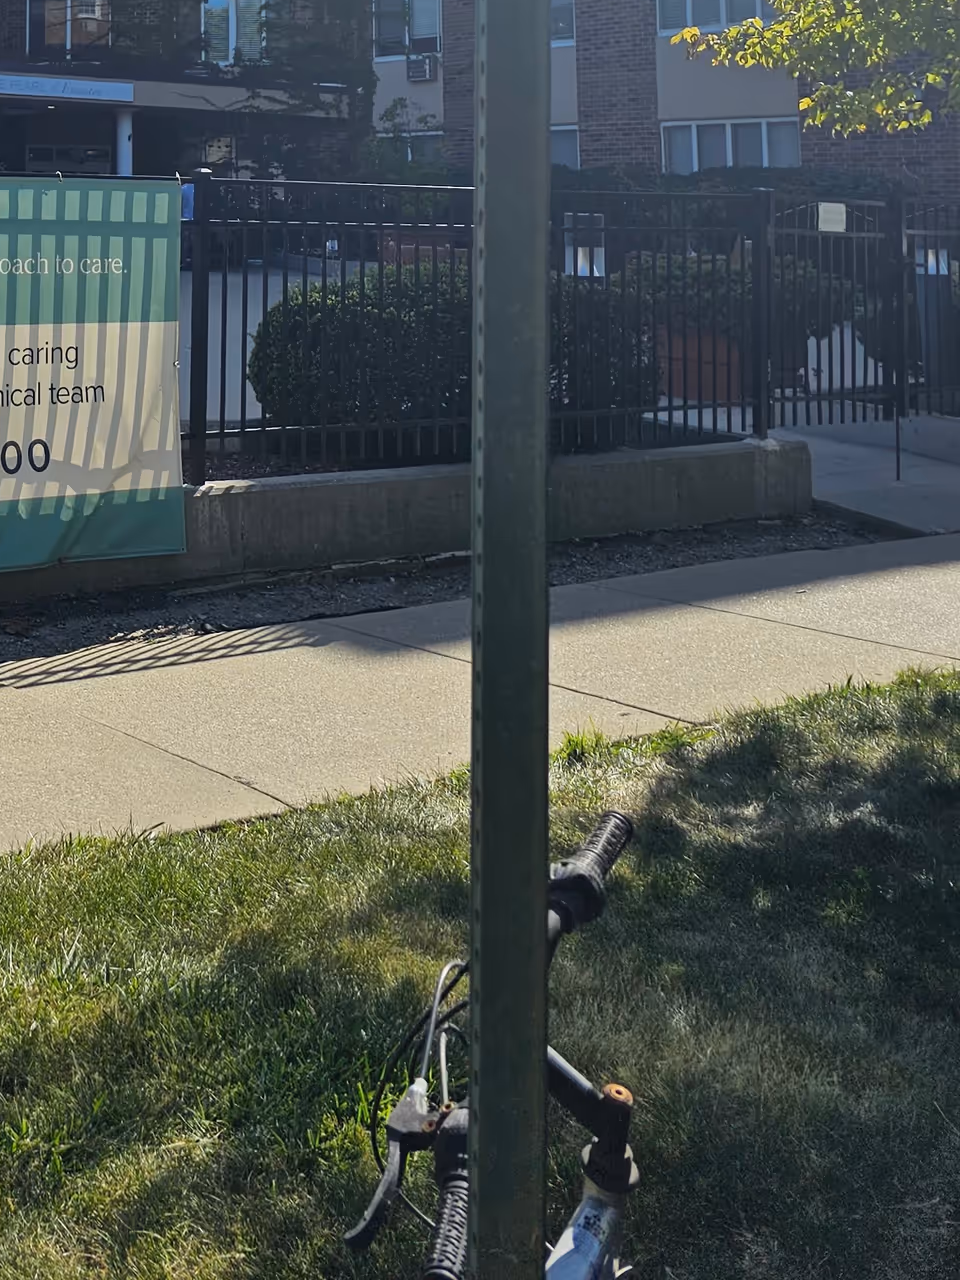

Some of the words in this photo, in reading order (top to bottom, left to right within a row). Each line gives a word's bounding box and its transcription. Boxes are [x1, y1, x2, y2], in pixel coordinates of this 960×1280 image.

[55, 255, 75, 275] to
[79, 255, 128, 275] care.
[7, 341, 80, 371] caring
[48, 383, 106, 406] team
